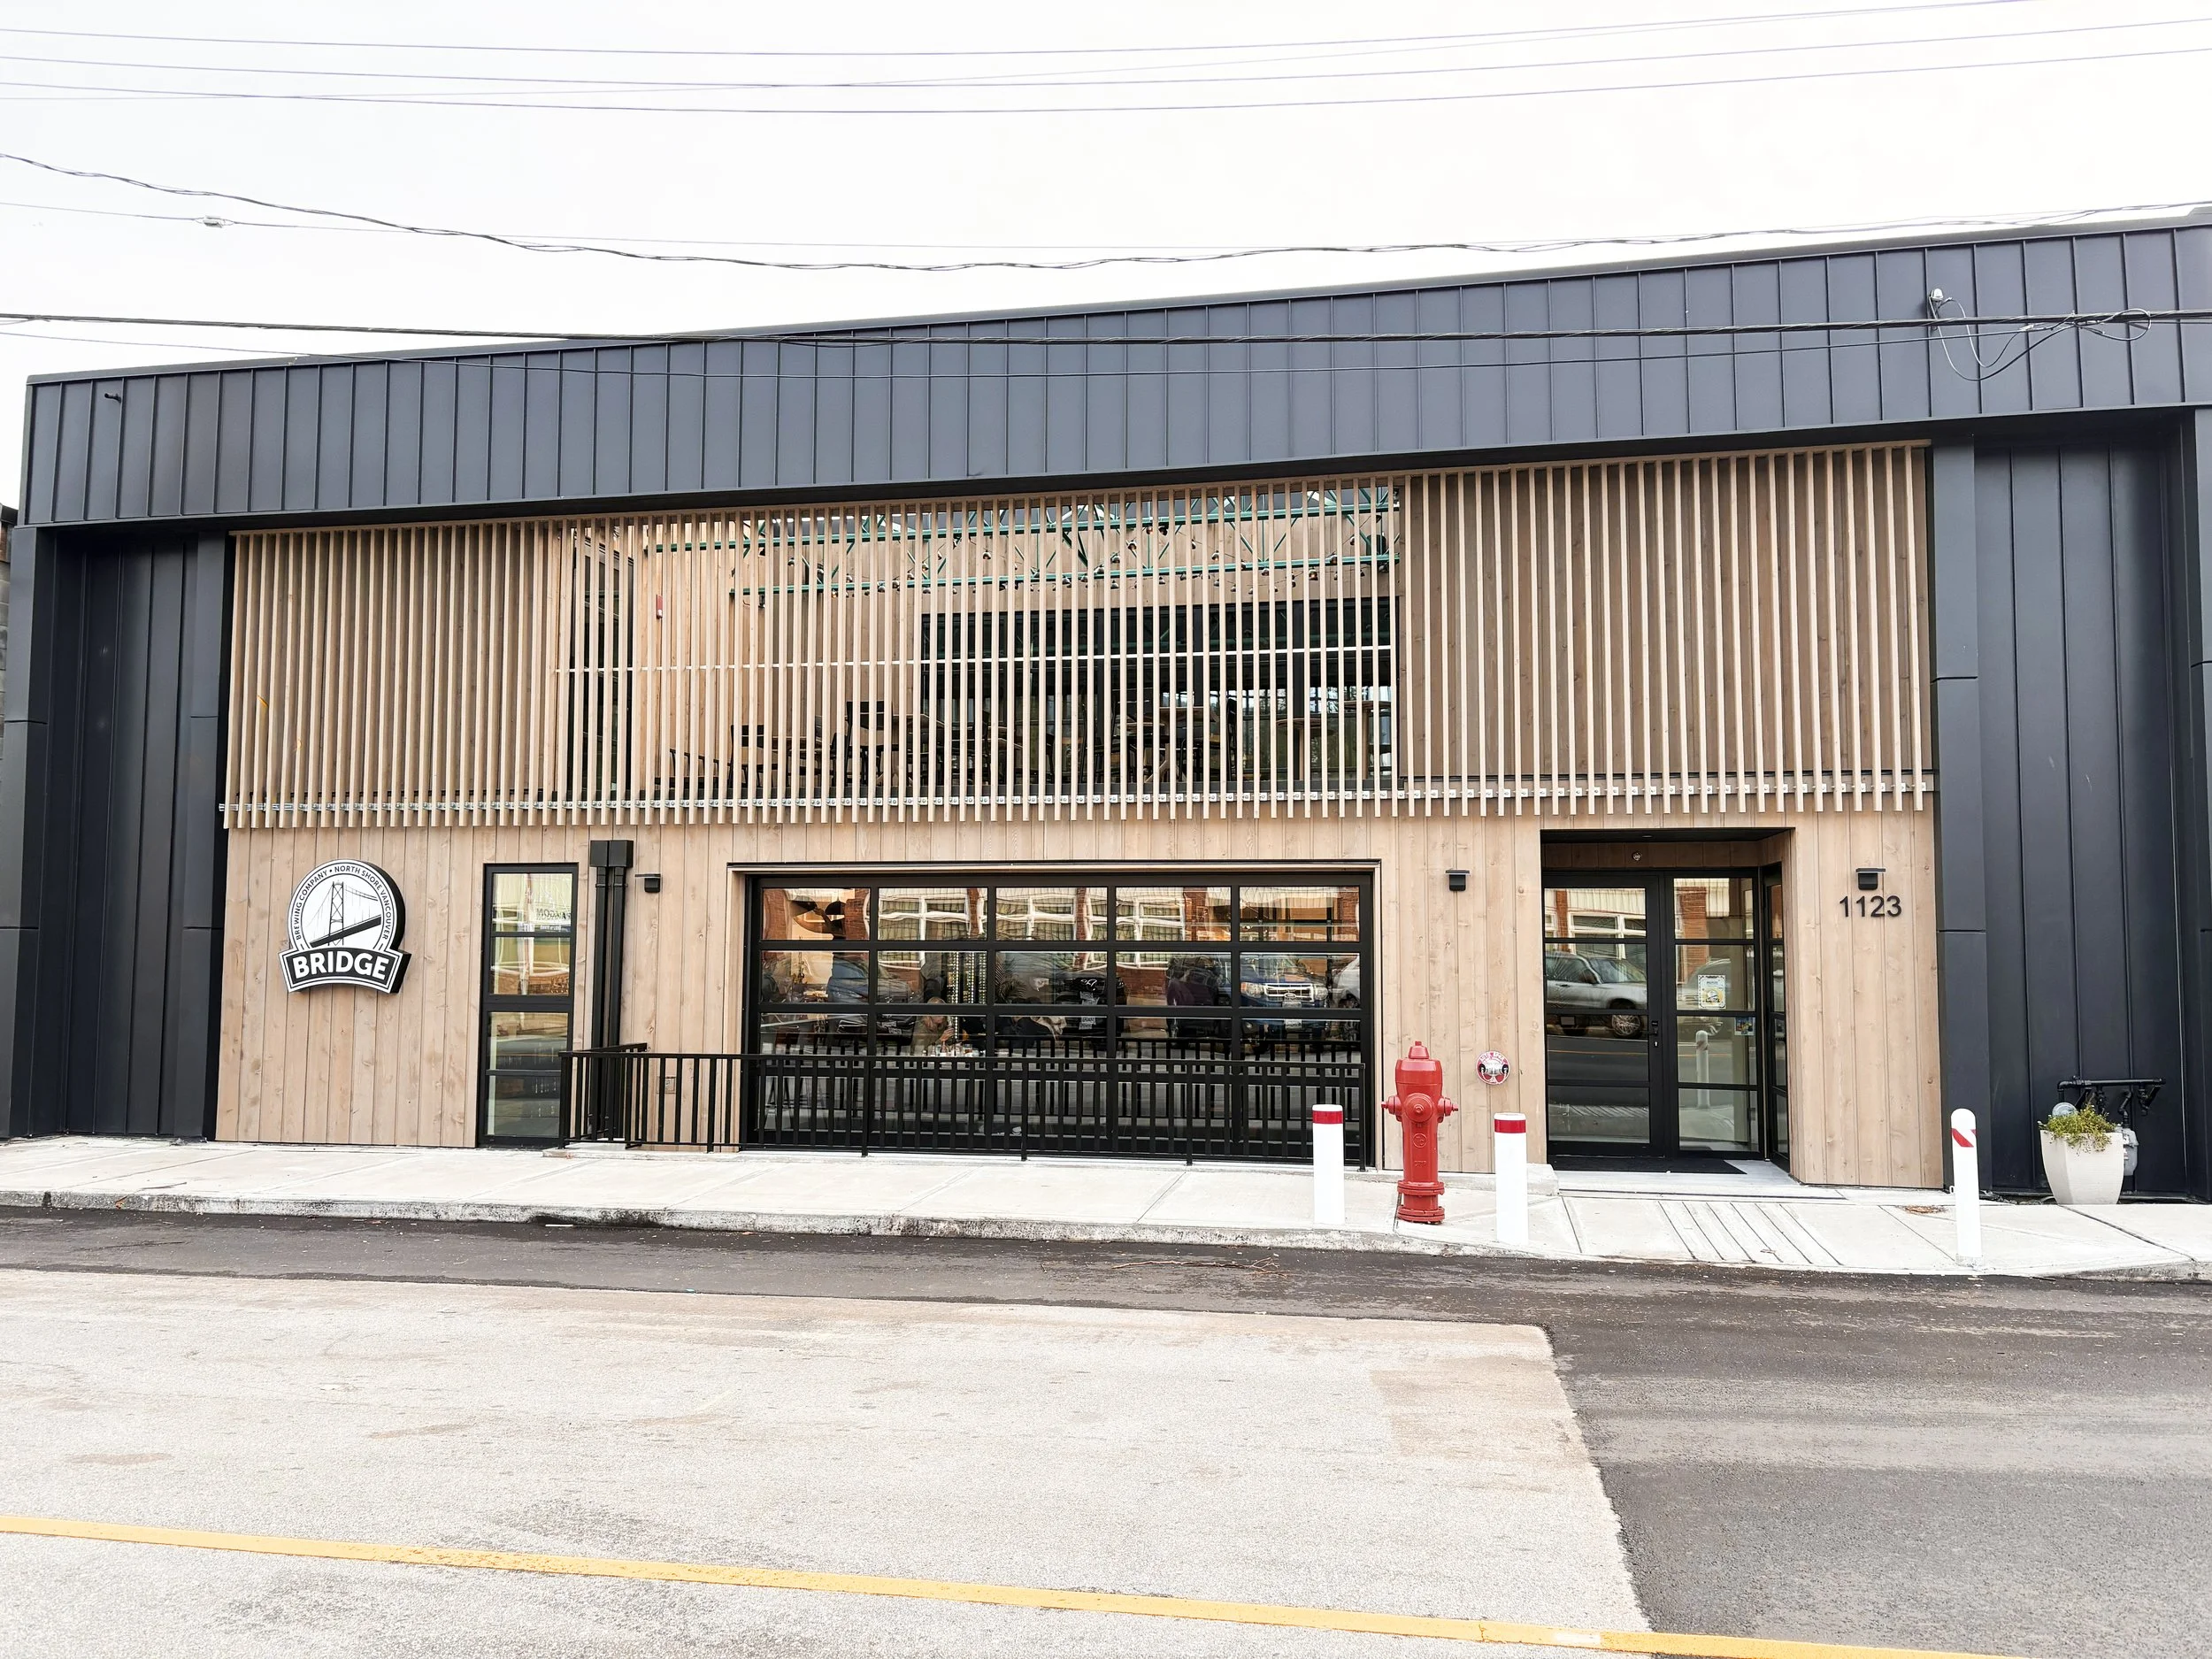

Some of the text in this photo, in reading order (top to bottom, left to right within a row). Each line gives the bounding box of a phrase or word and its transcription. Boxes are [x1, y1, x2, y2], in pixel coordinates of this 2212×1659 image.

[294, 865, 392, 941] BREWING COMPANY NORTH SHORE VANCOUVER
[1839, 895, 1902, 918] 1123
[292, 950, 389, 980] BRIDGE
